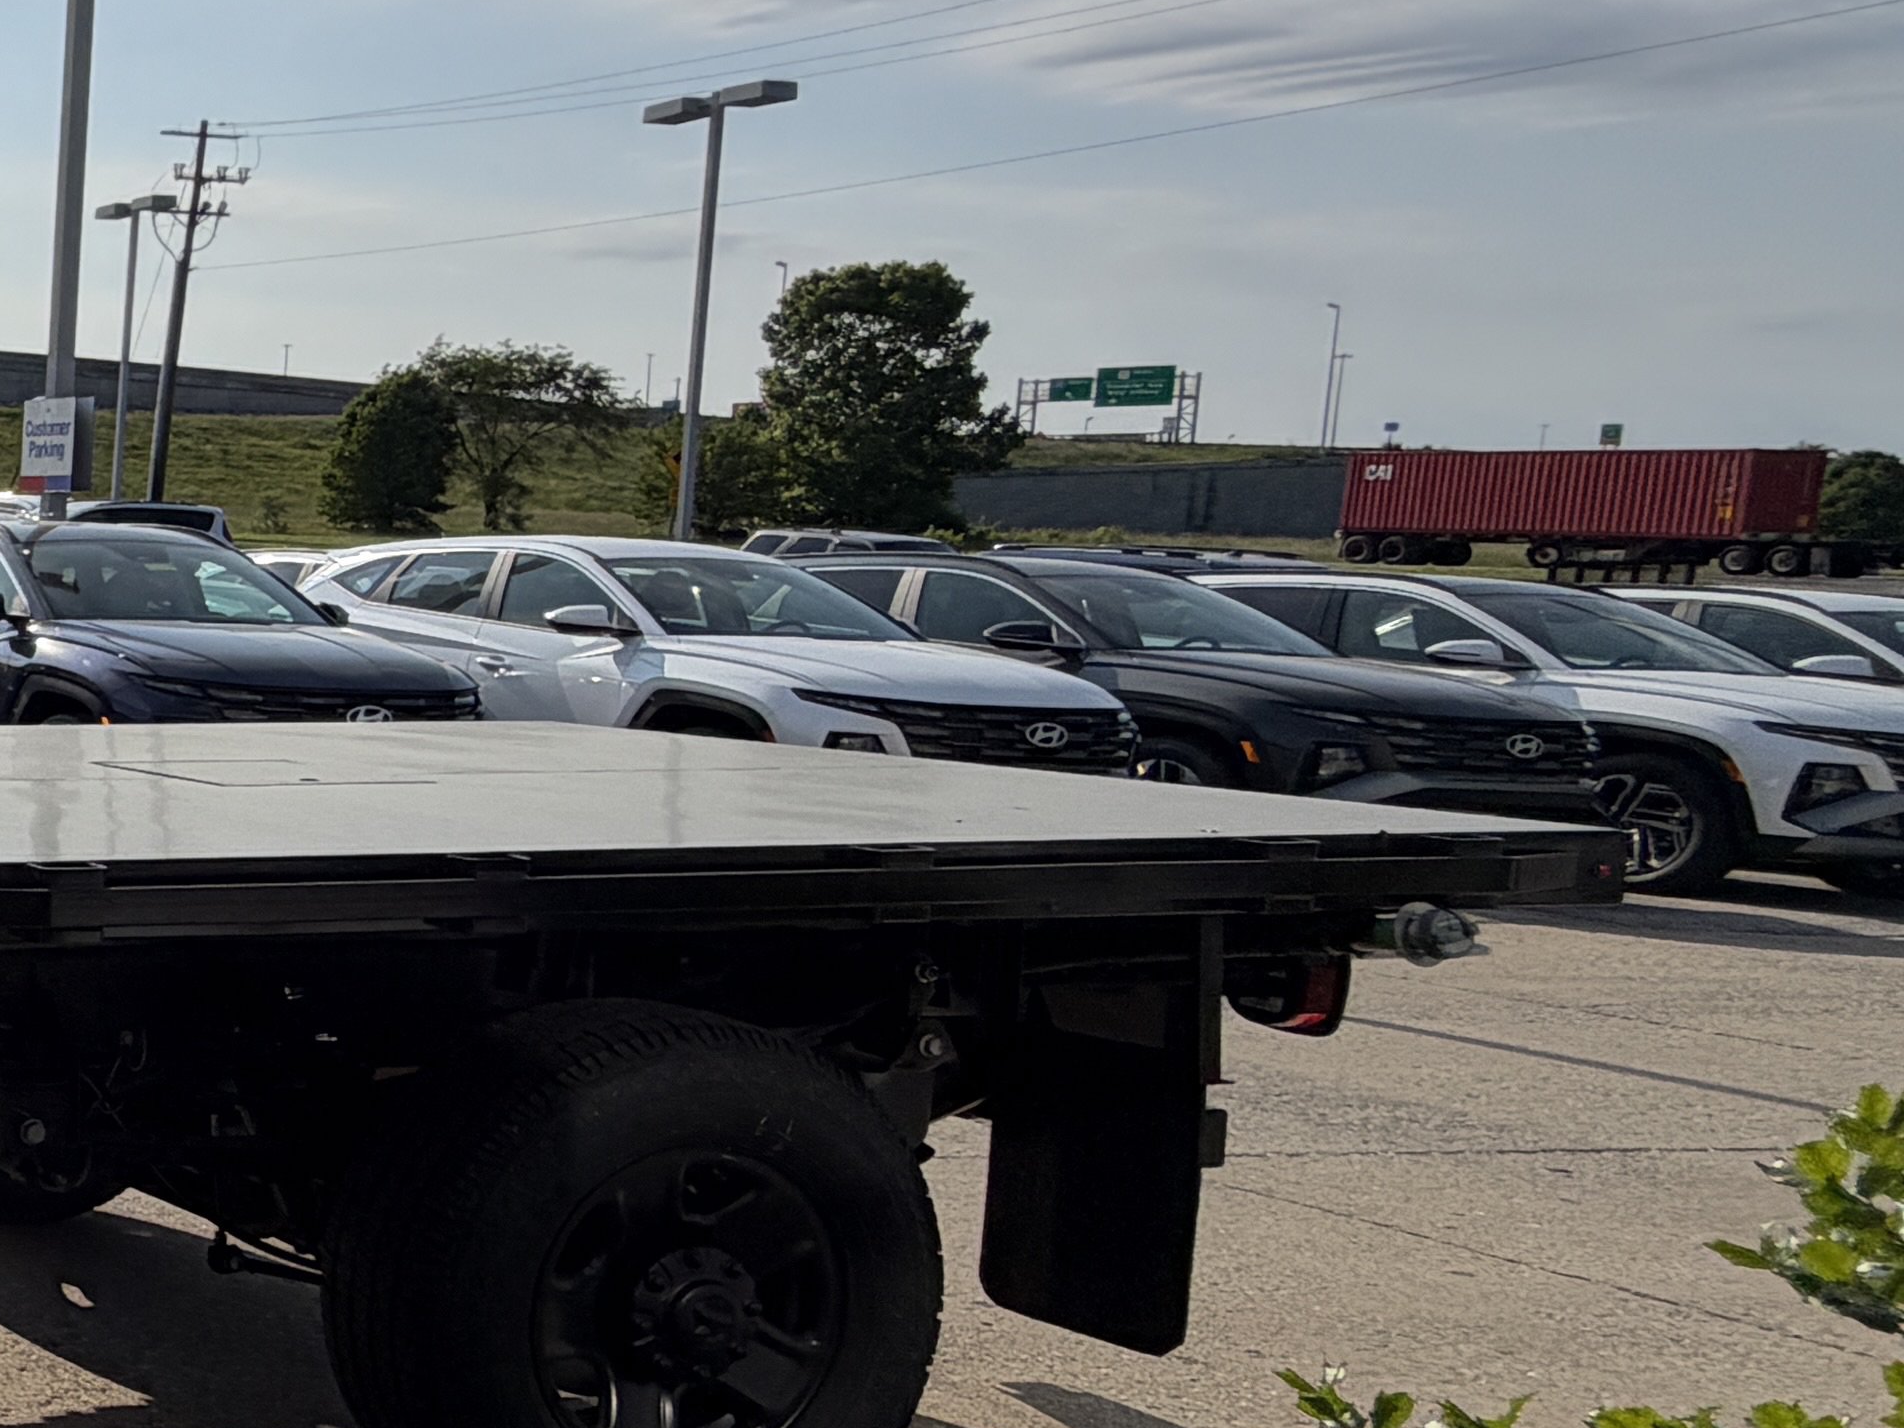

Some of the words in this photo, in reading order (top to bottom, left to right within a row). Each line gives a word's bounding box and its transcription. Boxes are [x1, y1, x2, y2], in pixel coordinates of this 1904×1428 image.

[25, 420, 71, 438] Customer
[29, 440, 65, 461] Parking
[1364, 464, 1393, 481] CAI
